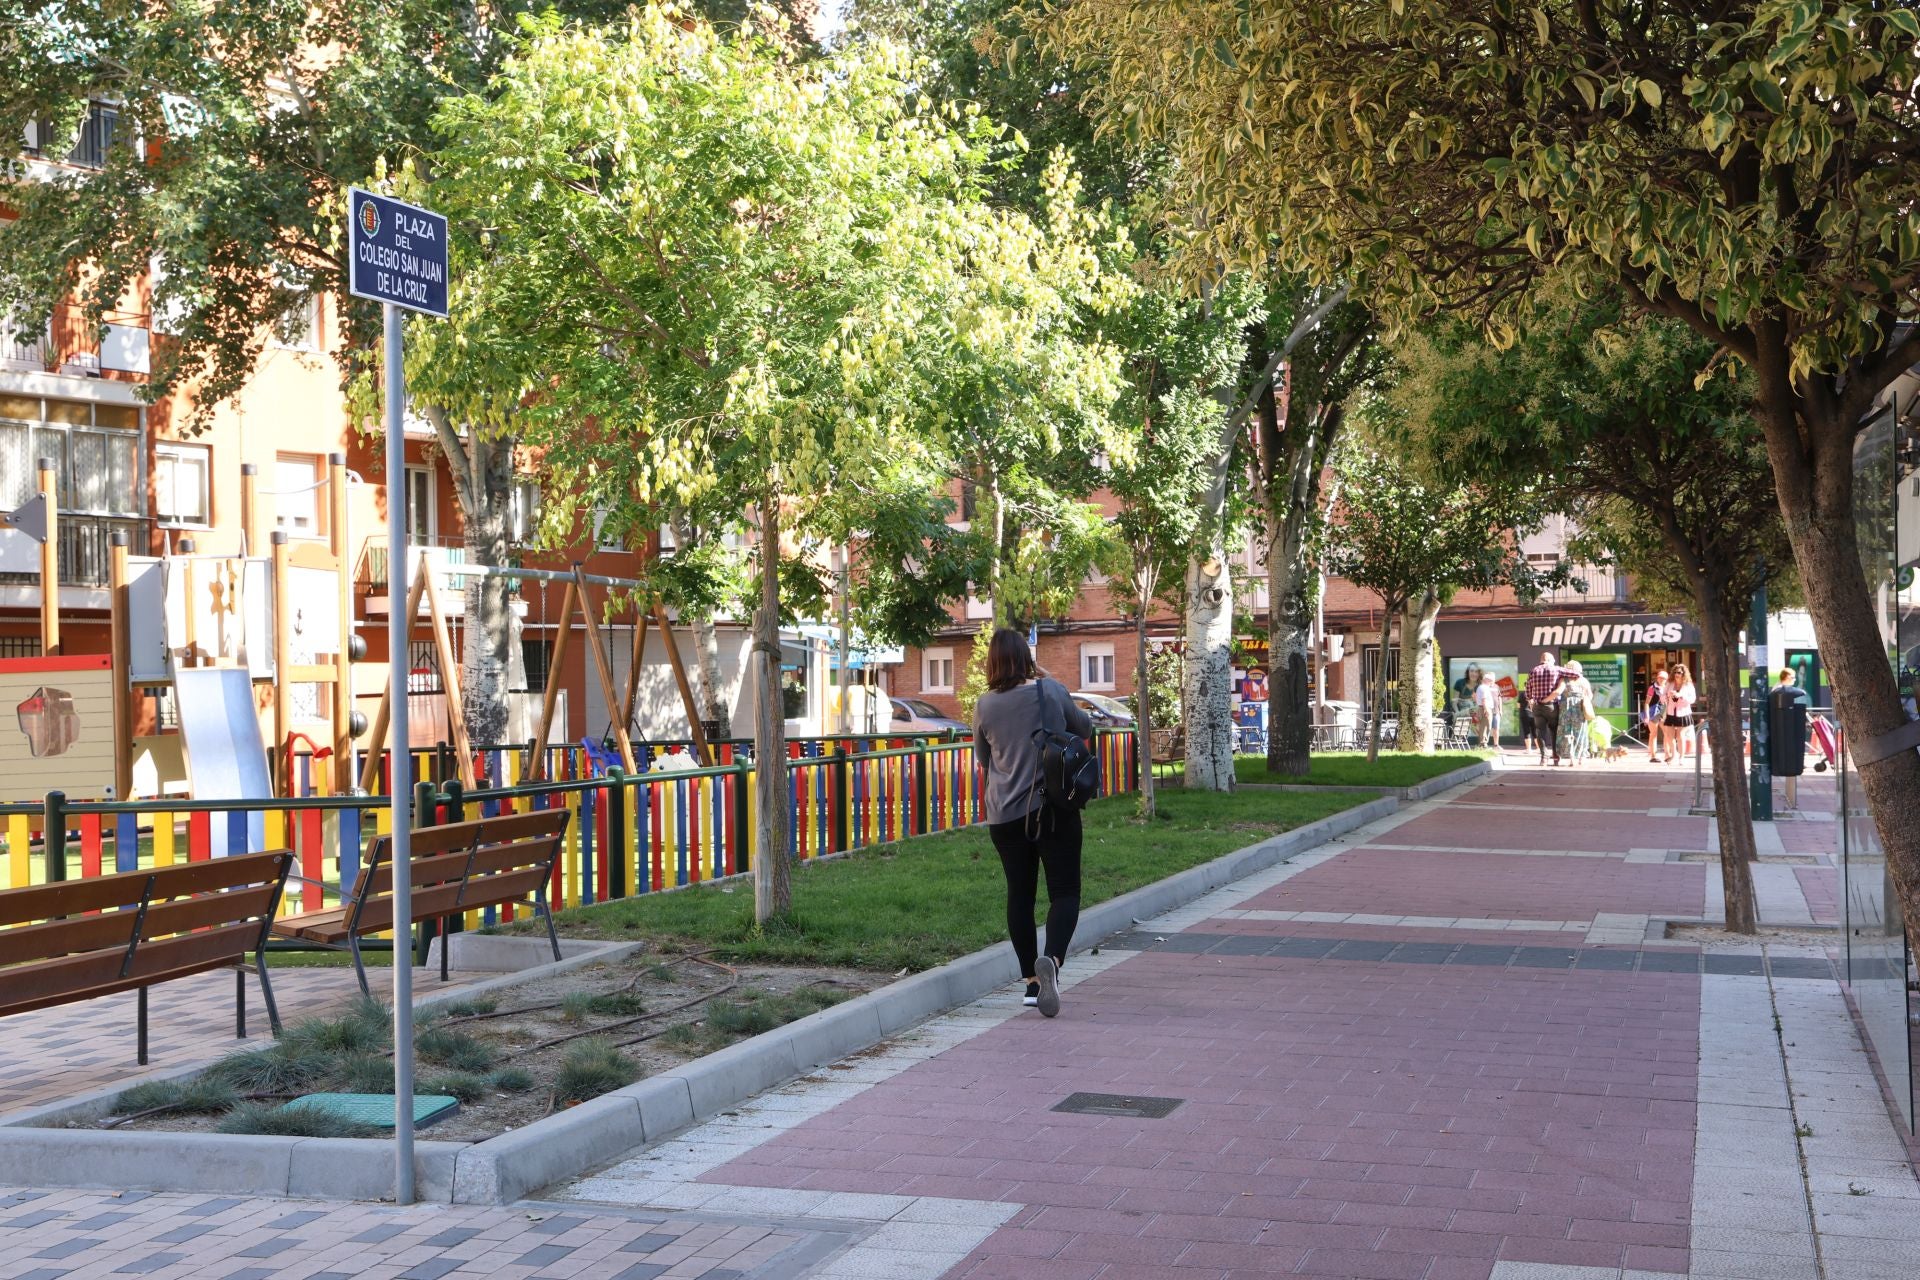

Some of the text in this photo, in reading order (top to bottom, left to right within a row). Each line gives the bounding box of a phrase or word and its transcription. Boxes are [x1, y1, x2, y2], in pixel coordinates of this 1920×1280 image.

[395, 212, 435, 241] PLAZA
[395, 234, 413, 250] DEL
[360, 241, 442, 284] COLEGIO SAN JUAN
[377, 271, 428, 304] DE LA CRUZ
[1531, 619, 1683, 650] minymas
